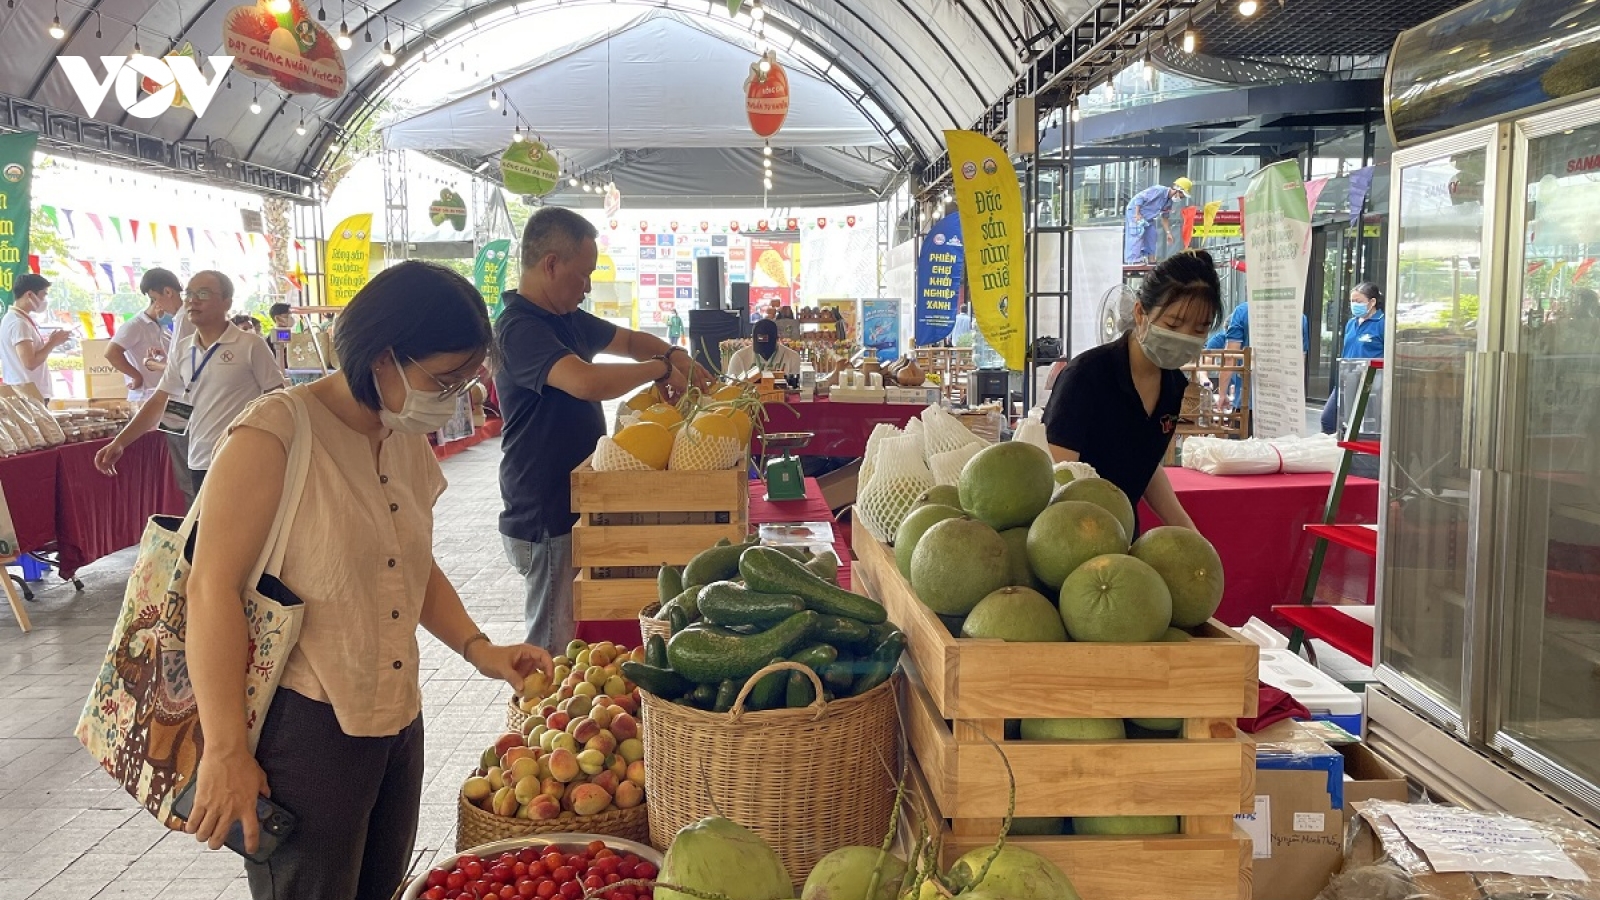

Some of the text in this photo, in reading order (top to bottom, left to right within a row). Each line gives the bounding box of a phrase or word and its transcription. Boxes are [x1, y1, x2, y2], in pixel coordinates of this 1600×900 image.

[974, 190, 1003, 215] Đặc
[980, 212, 1008, 240] sản
[929, 252, 957, 264] PHIÊN
[931, 264, 953, 275] CHỢ
[923, 287, 956, 300] NGHIỆP
[926, 300, 951, 311] XANH
